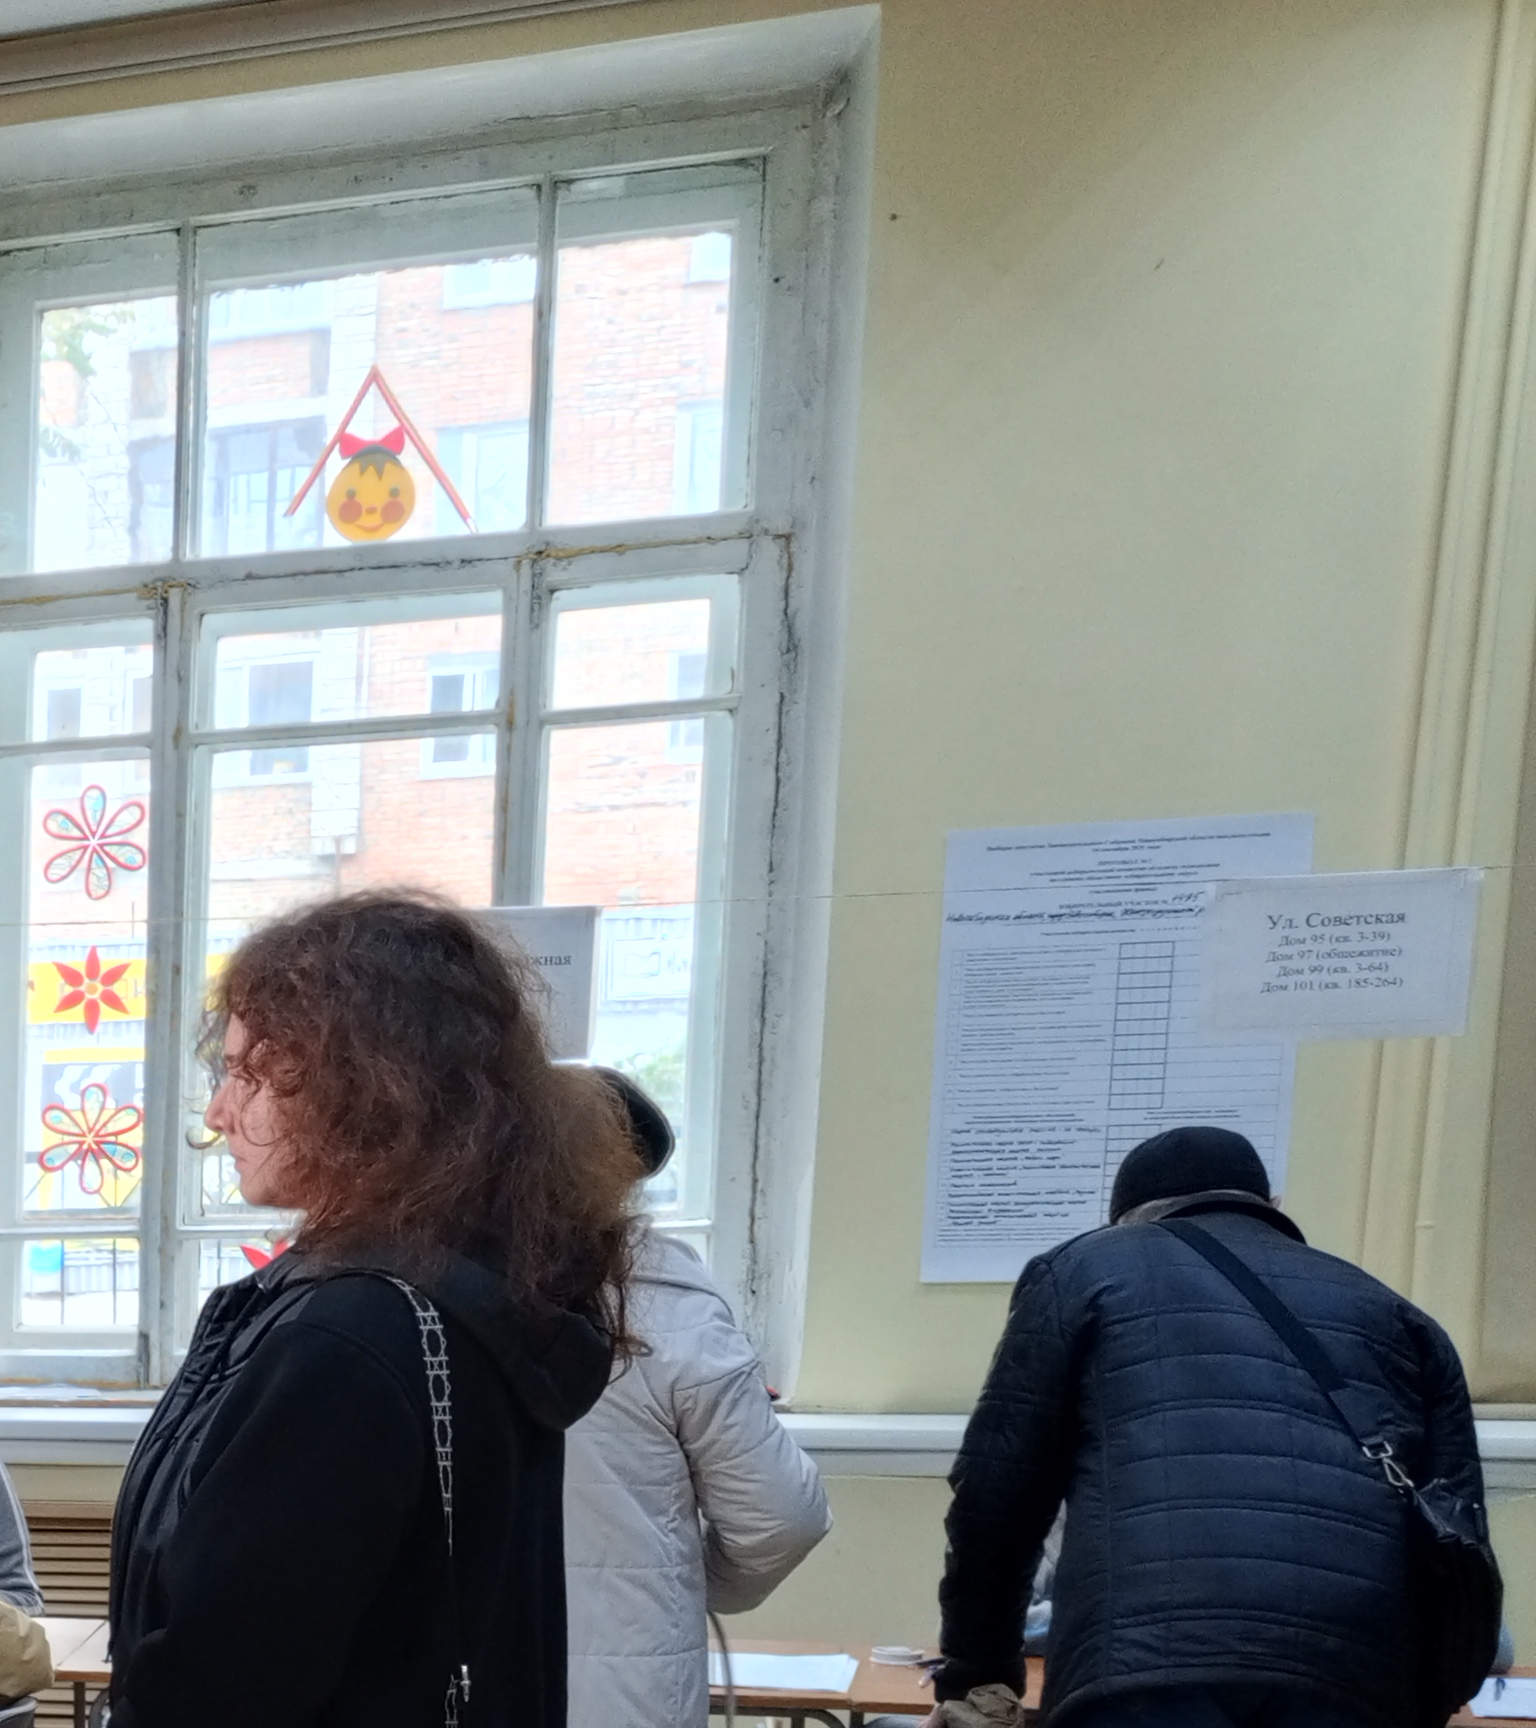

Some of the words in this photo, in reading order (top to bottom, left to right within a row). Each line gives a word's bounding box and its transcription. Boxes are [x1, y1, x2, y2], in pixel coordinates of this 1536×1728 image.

[1267, 914, 1298, 930] Ул.
[1305, 912, 1406, 928] Советская
[1278, 935, 1306, 947] Дом
[1265, 951, 1294, 963] Дом
[1316, 948, 1403, 960] (общежитие)
[1277, 965, 1304, 978] Дом
[1260, 981, 1288, 994] Дом
[1293, 981, 1315, 991] 101
